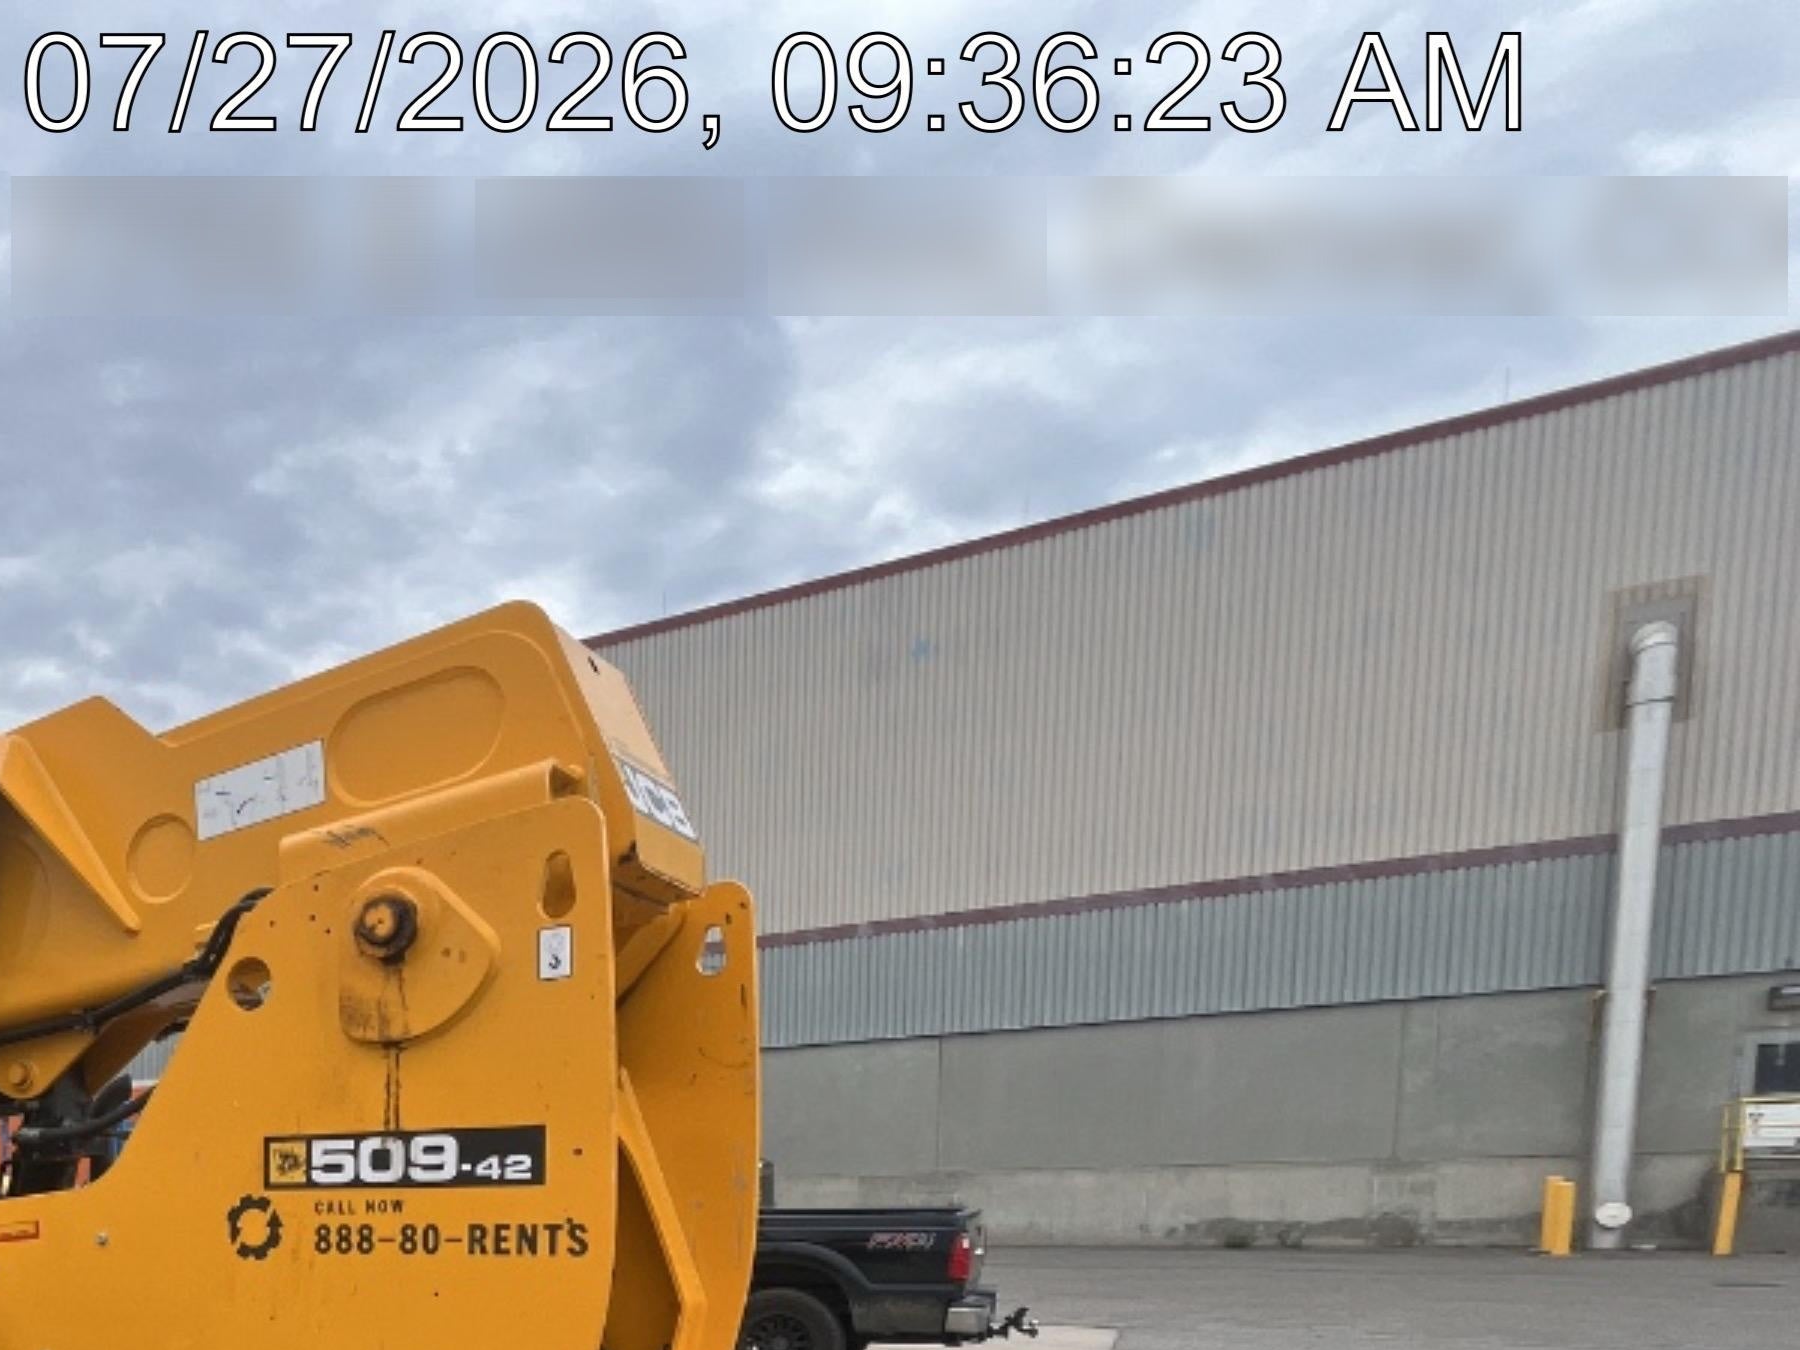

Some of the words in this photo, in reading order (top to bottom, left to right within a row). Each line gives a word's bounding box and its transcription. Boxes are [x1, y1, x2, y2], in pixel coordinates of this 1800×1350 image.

[310, 1134, 533, 1184] 509-42
[314, 1200, 356, 1215] CALL
[365, 1199, 404, 1214] NOW
